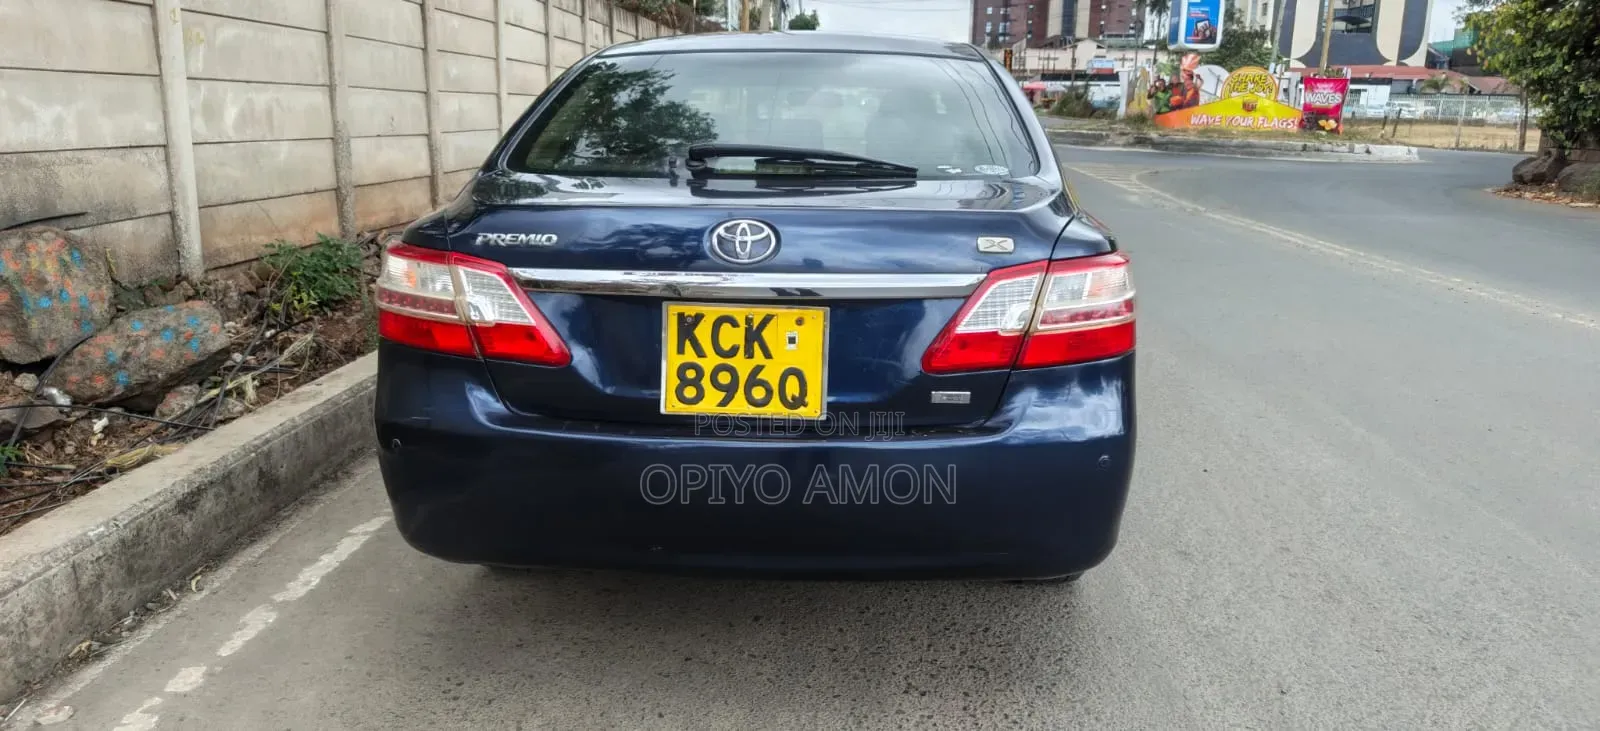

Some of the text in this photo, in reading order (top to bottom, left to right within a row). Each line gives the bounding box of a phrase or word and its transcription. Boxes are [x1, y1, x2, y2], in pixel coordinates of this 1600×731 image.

[1231, 73, 1268, 84] SHARE
[1229, 82, 1249, 93] THE
[1306, 92, 1342, 104] WAVES
[1190, 113, 1298, 129] WAVE YOUR FLAGS!
[475, 232, 558, 247] PREMIO
[676, 312, 774, 359] KCK
[675, 361, 809, 410] 896Q
